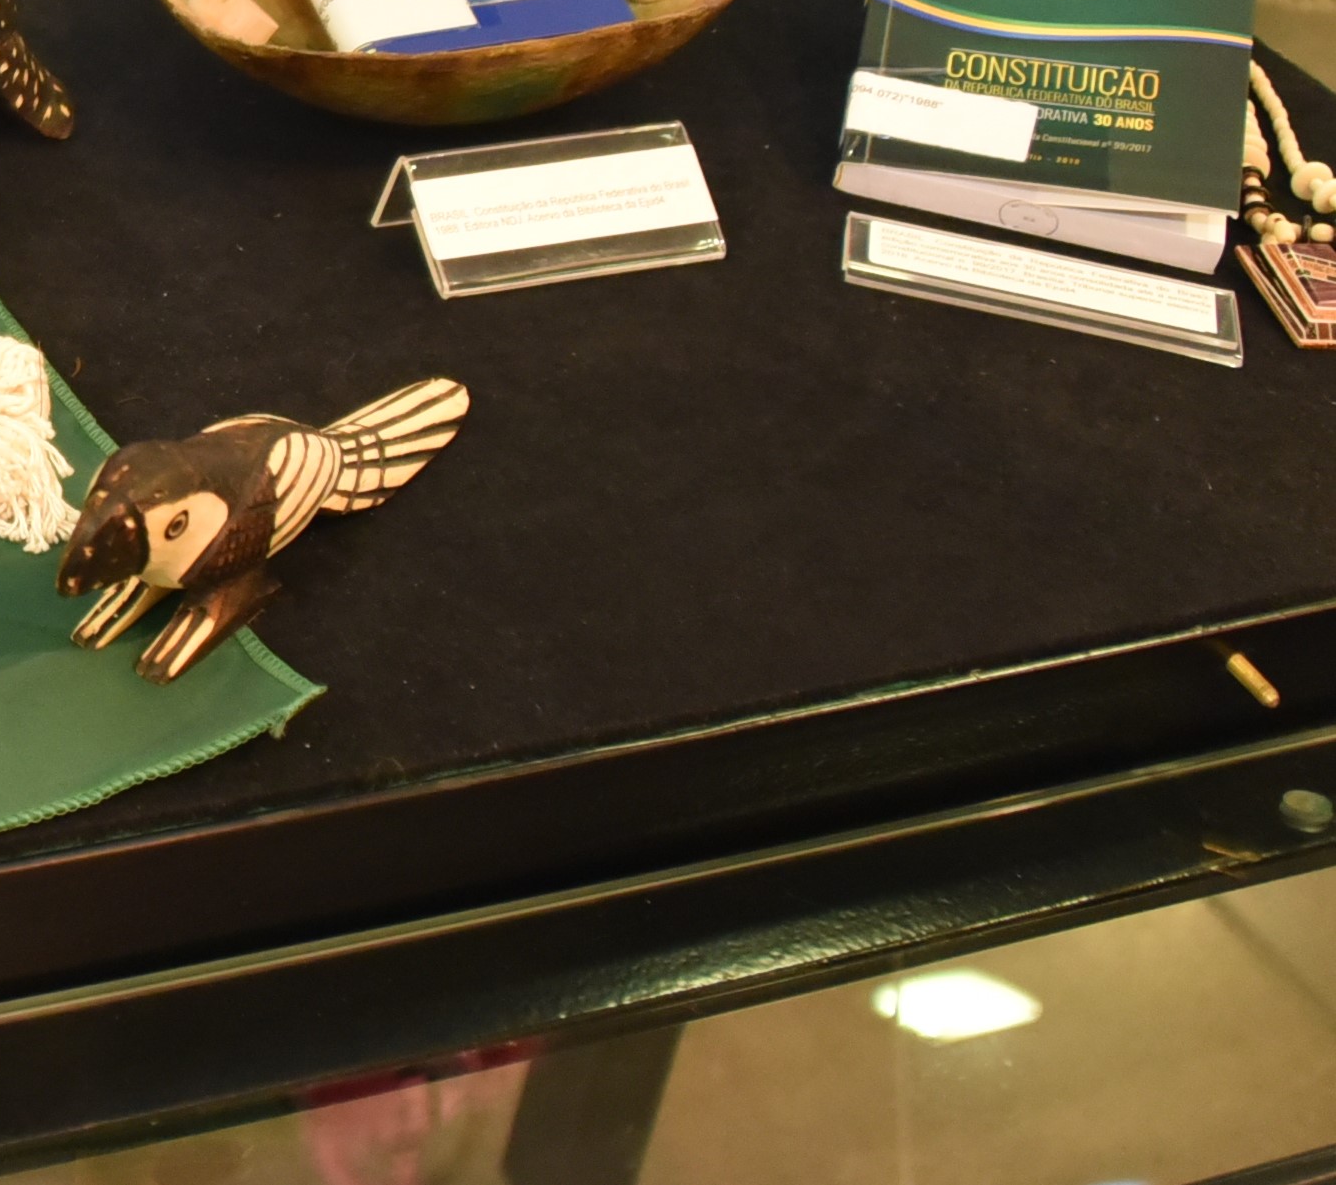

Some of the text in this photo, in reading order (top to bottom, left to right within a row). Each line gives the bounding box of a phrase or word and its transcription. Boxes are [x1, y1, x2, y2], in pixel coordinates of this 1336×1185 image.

[946, 51, 1161, 100] CONSTITUIÇÃO
[963, 80, 1025, 99] REPÚBLICA
[1026, 89, 1092, 107] FEDERATIVA
[1095, 97, 1112, 109] DO
[1114, 99, 1155, 114] BRASIL
[1037, 108, 1155, 132] ORATIVA 30 ANOS
